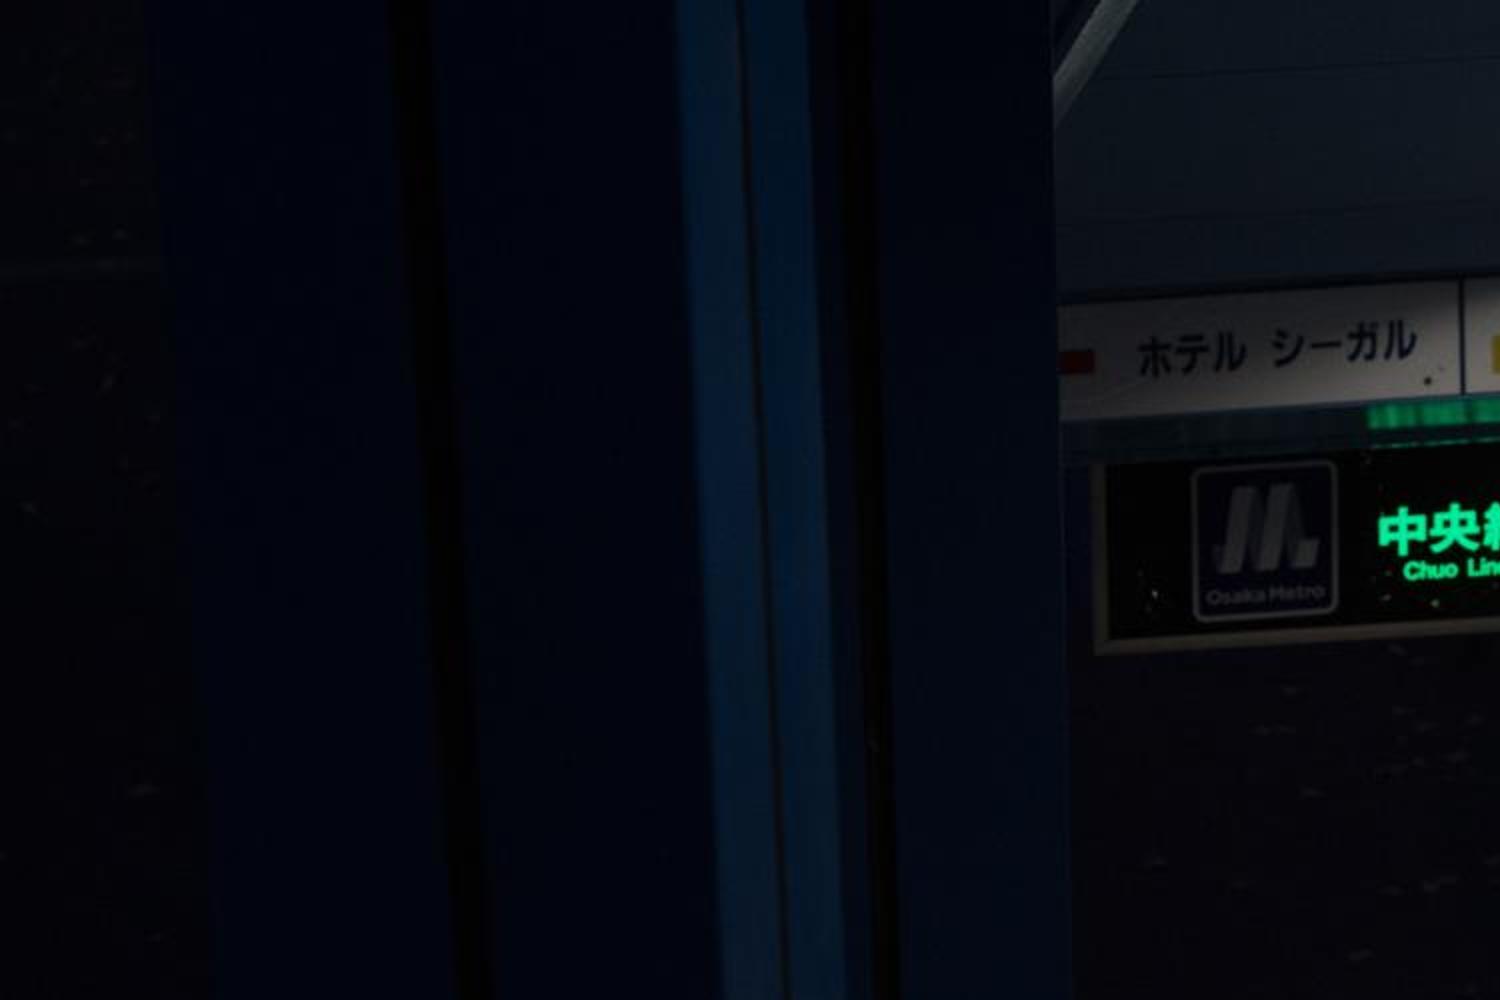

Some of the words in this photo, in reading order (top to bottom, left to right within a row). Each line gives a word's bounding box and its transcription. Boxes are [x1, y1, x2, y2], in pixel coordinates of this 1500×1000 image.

[1138, 332, 1246, 377] ホテル
[1272, 320, 1417, 366] シーガル
[1403, 561, 1458, 582] Chuo
[1205, 589, 1265, 606] Osaka
[1268, 584, 1327, 602] Metro
